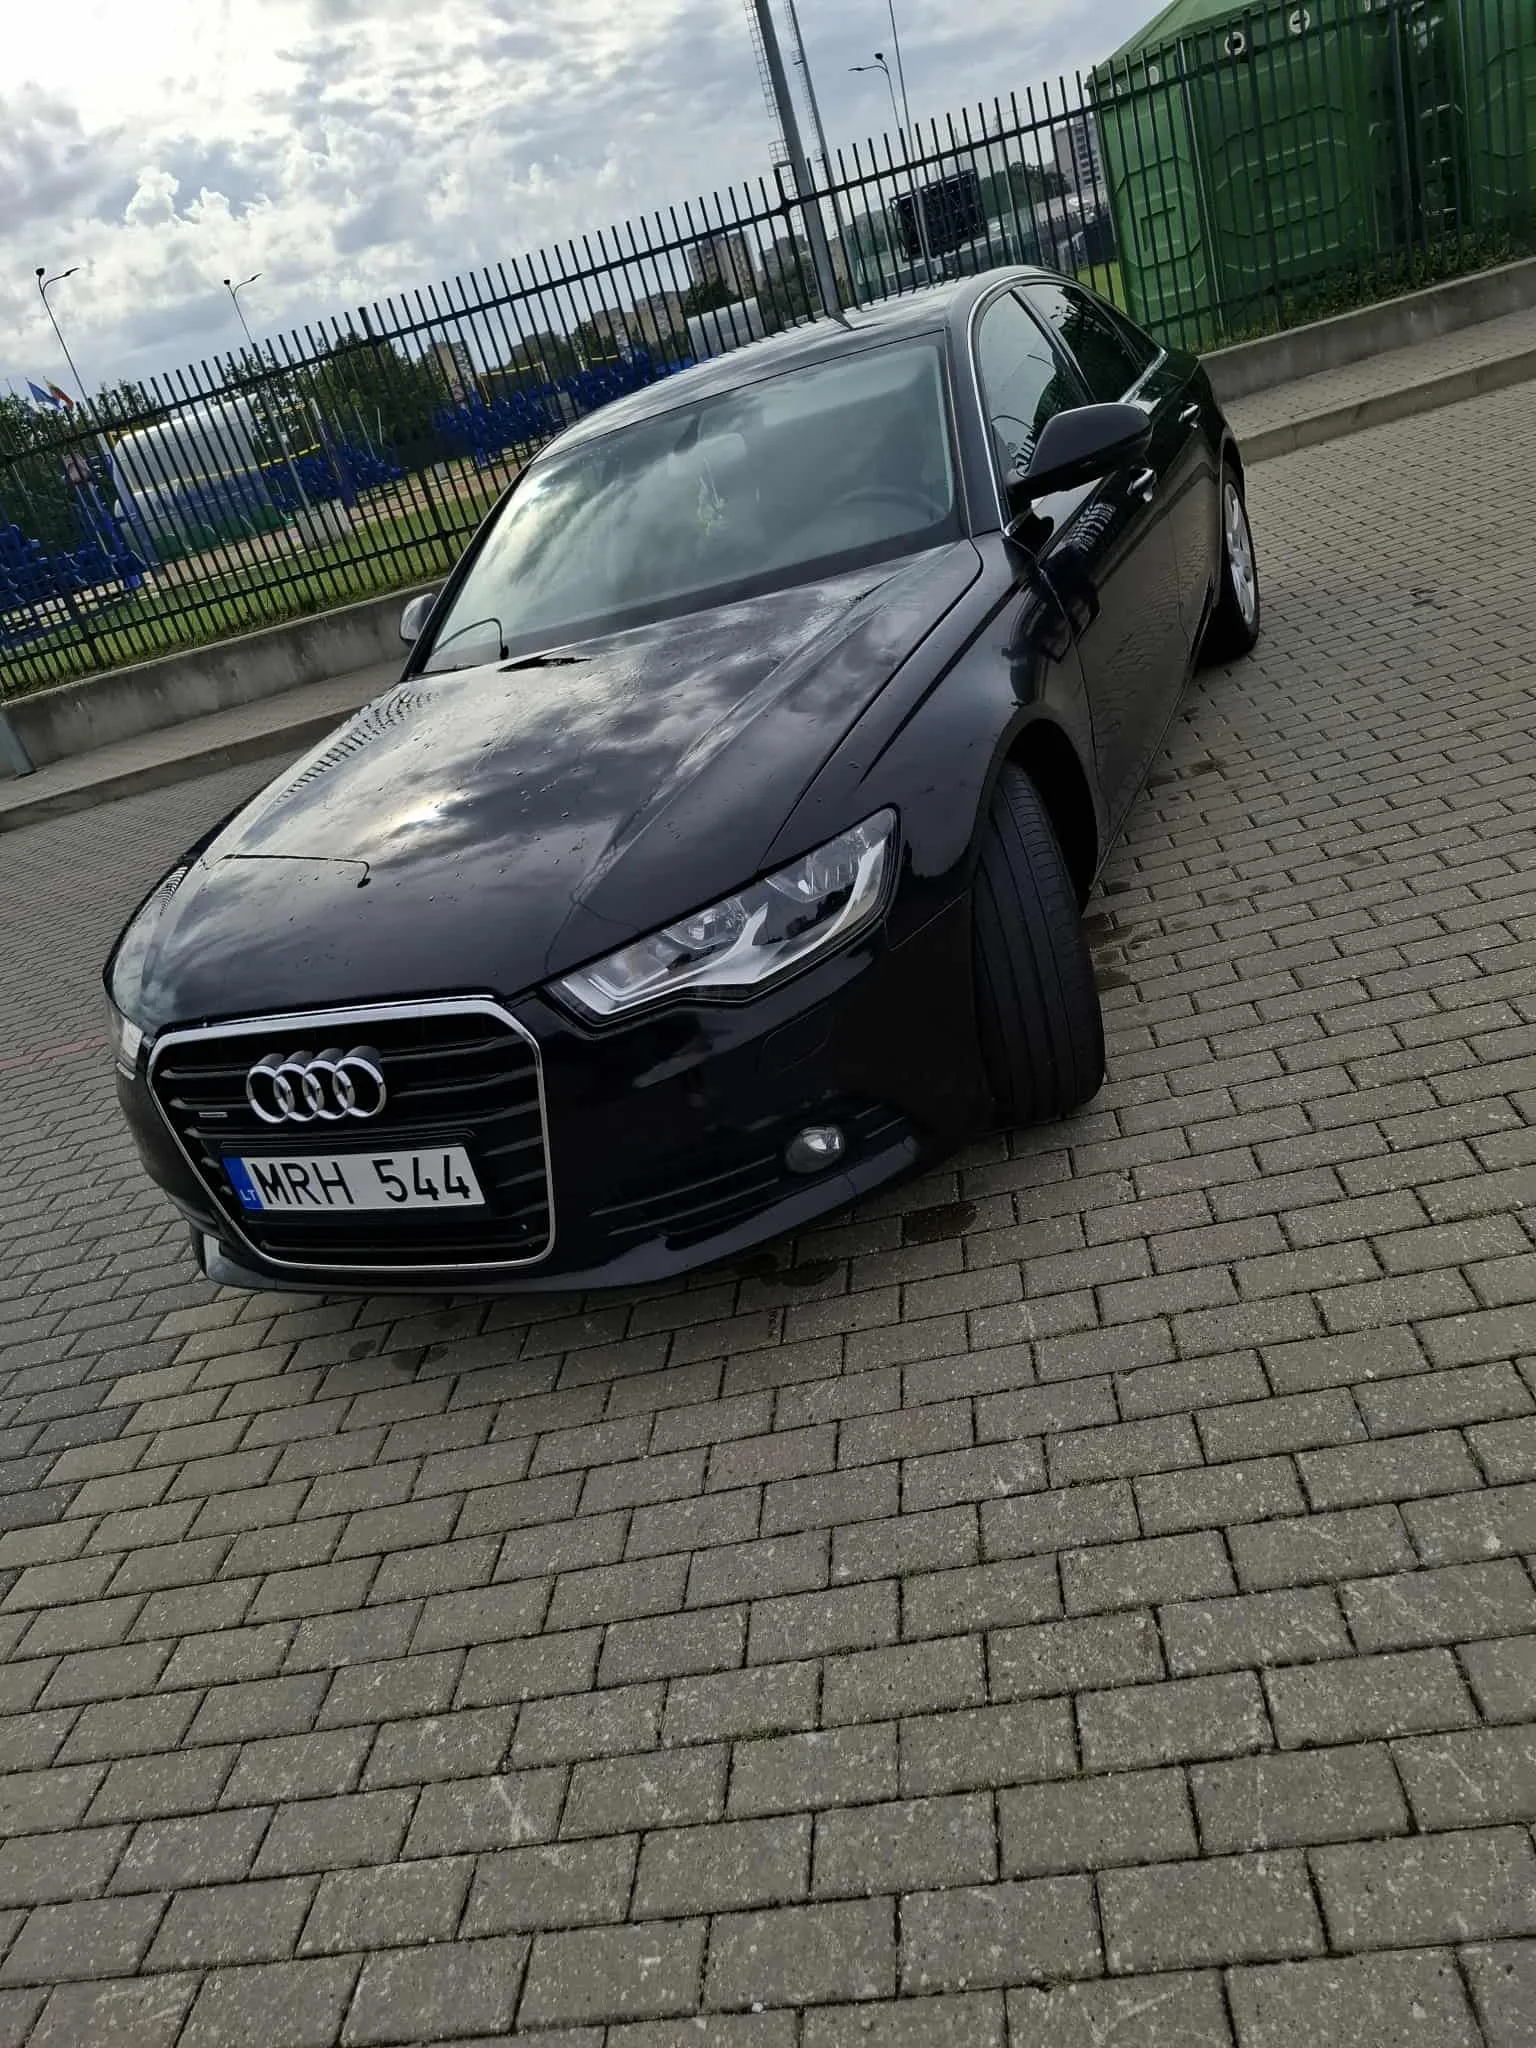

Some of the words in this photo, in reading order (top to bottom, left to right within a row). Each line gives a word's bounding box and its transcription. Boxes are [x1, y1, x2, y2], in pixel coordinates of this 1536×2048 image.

[251, 1161, 354, 1204] MRH
[372, 1154, 470, 1203] 544
[240, 1189, 257, 1201] LT
